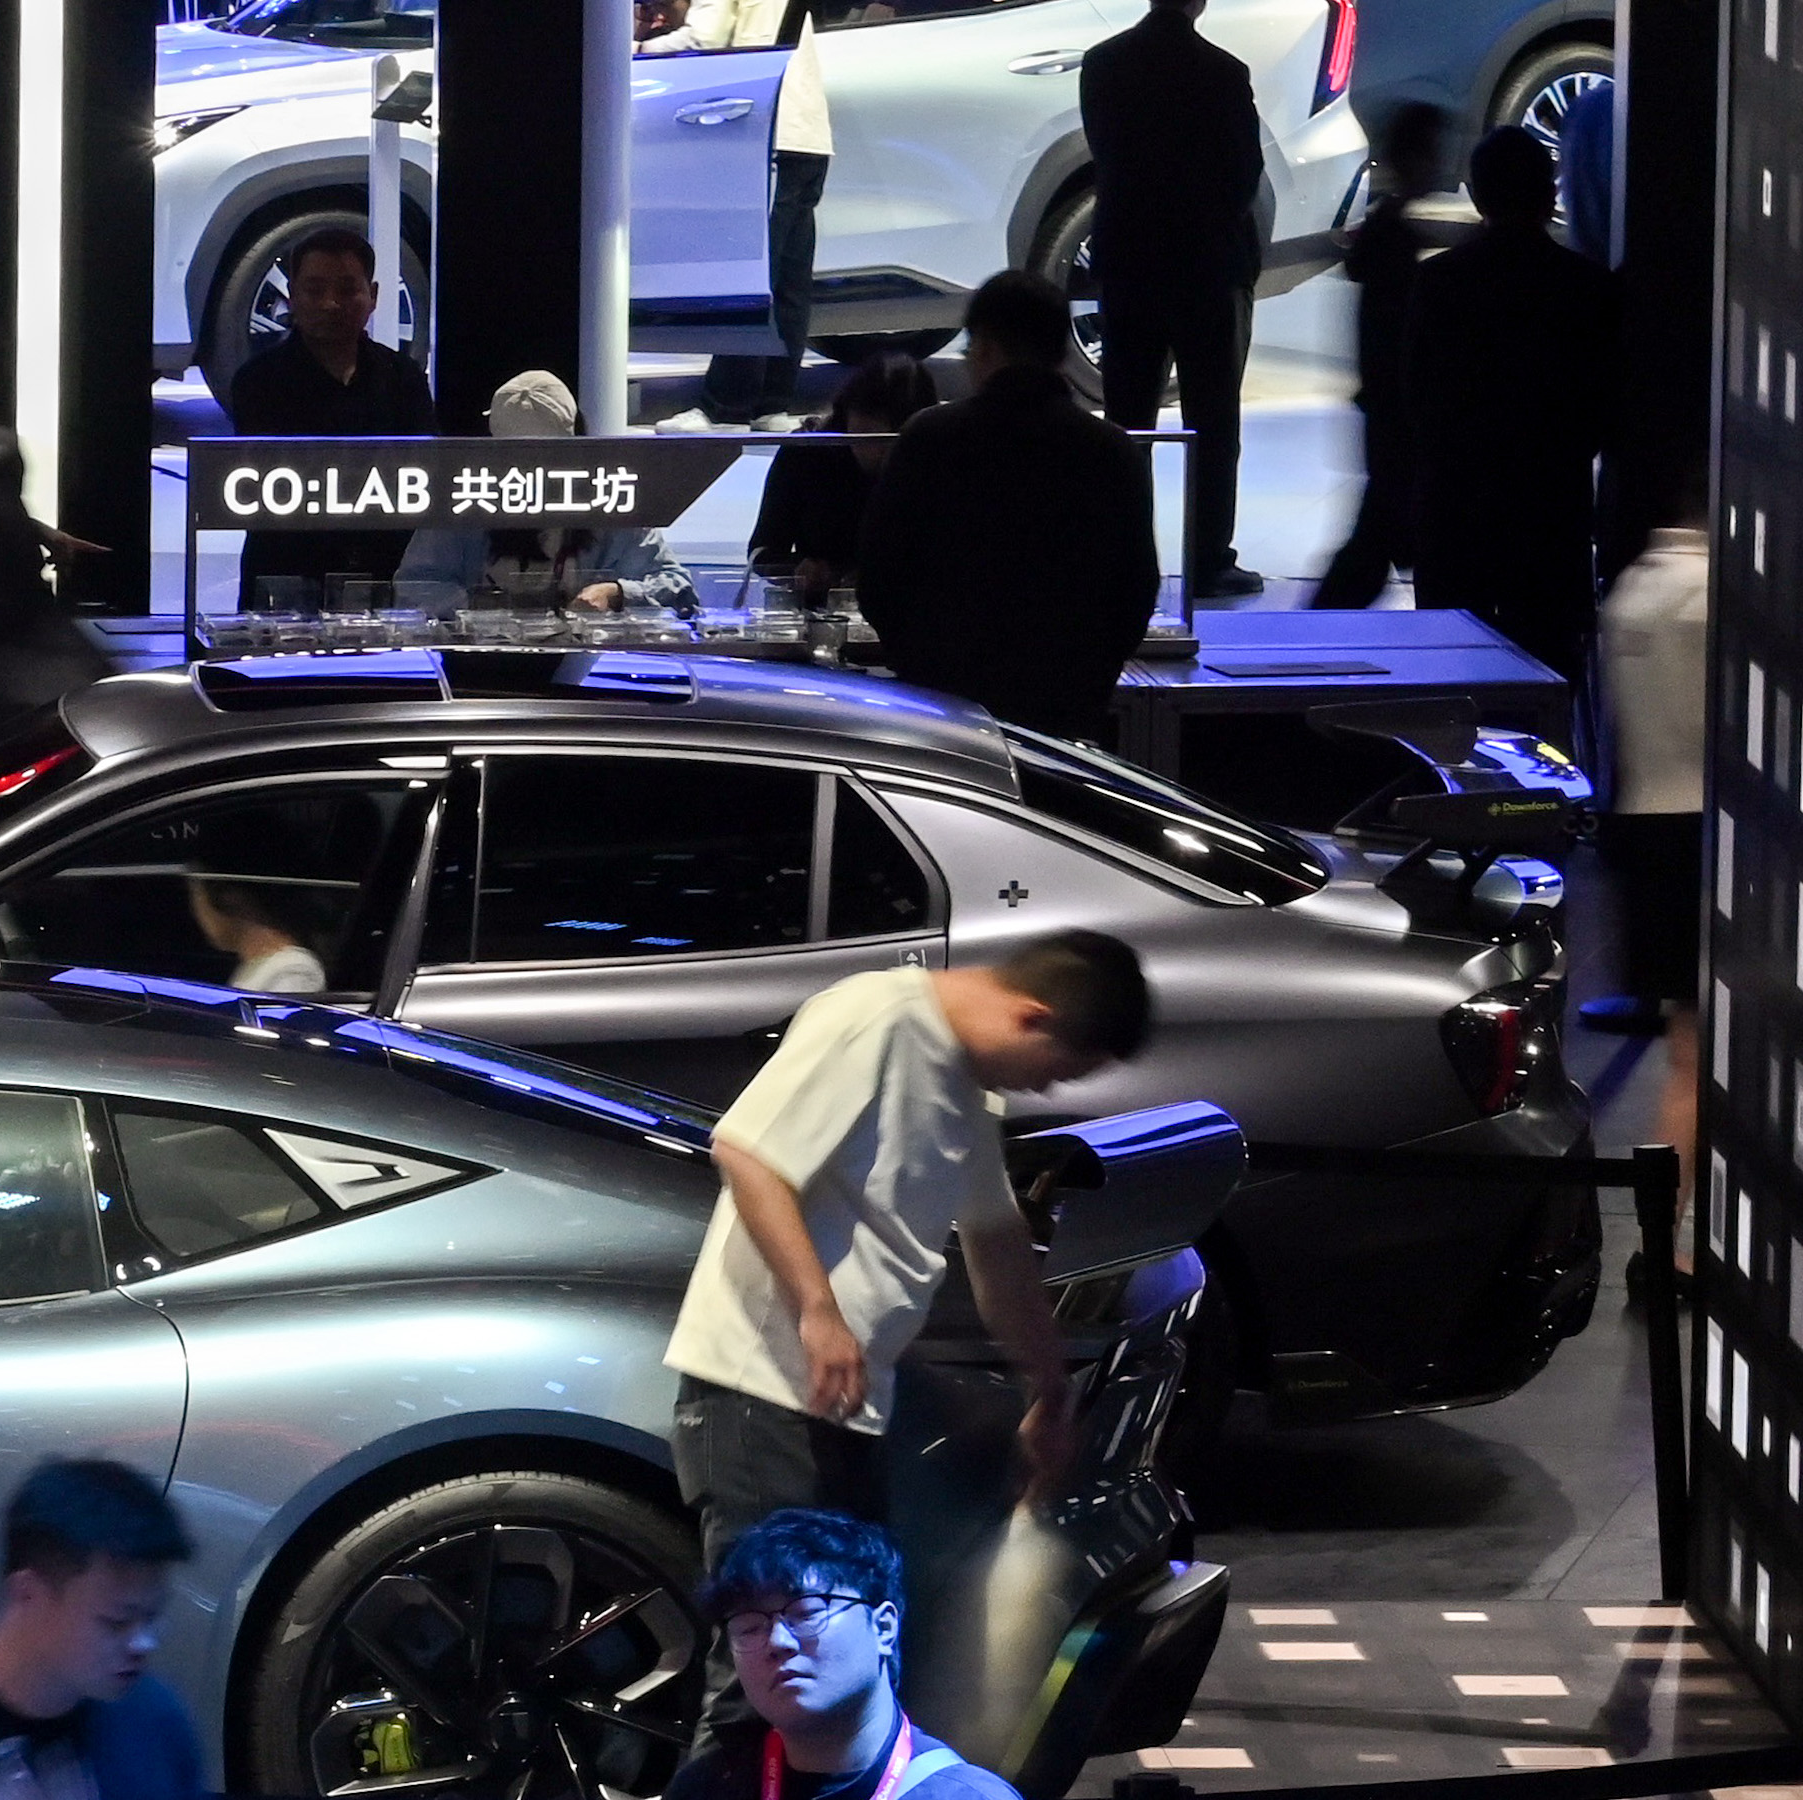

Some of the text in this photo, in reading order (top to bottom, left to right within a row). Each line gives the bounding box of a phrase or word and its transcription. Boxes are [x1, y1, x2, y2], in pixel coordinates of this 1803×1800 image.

[223, 466, 638, 515] CO:LAB 共创工坊
